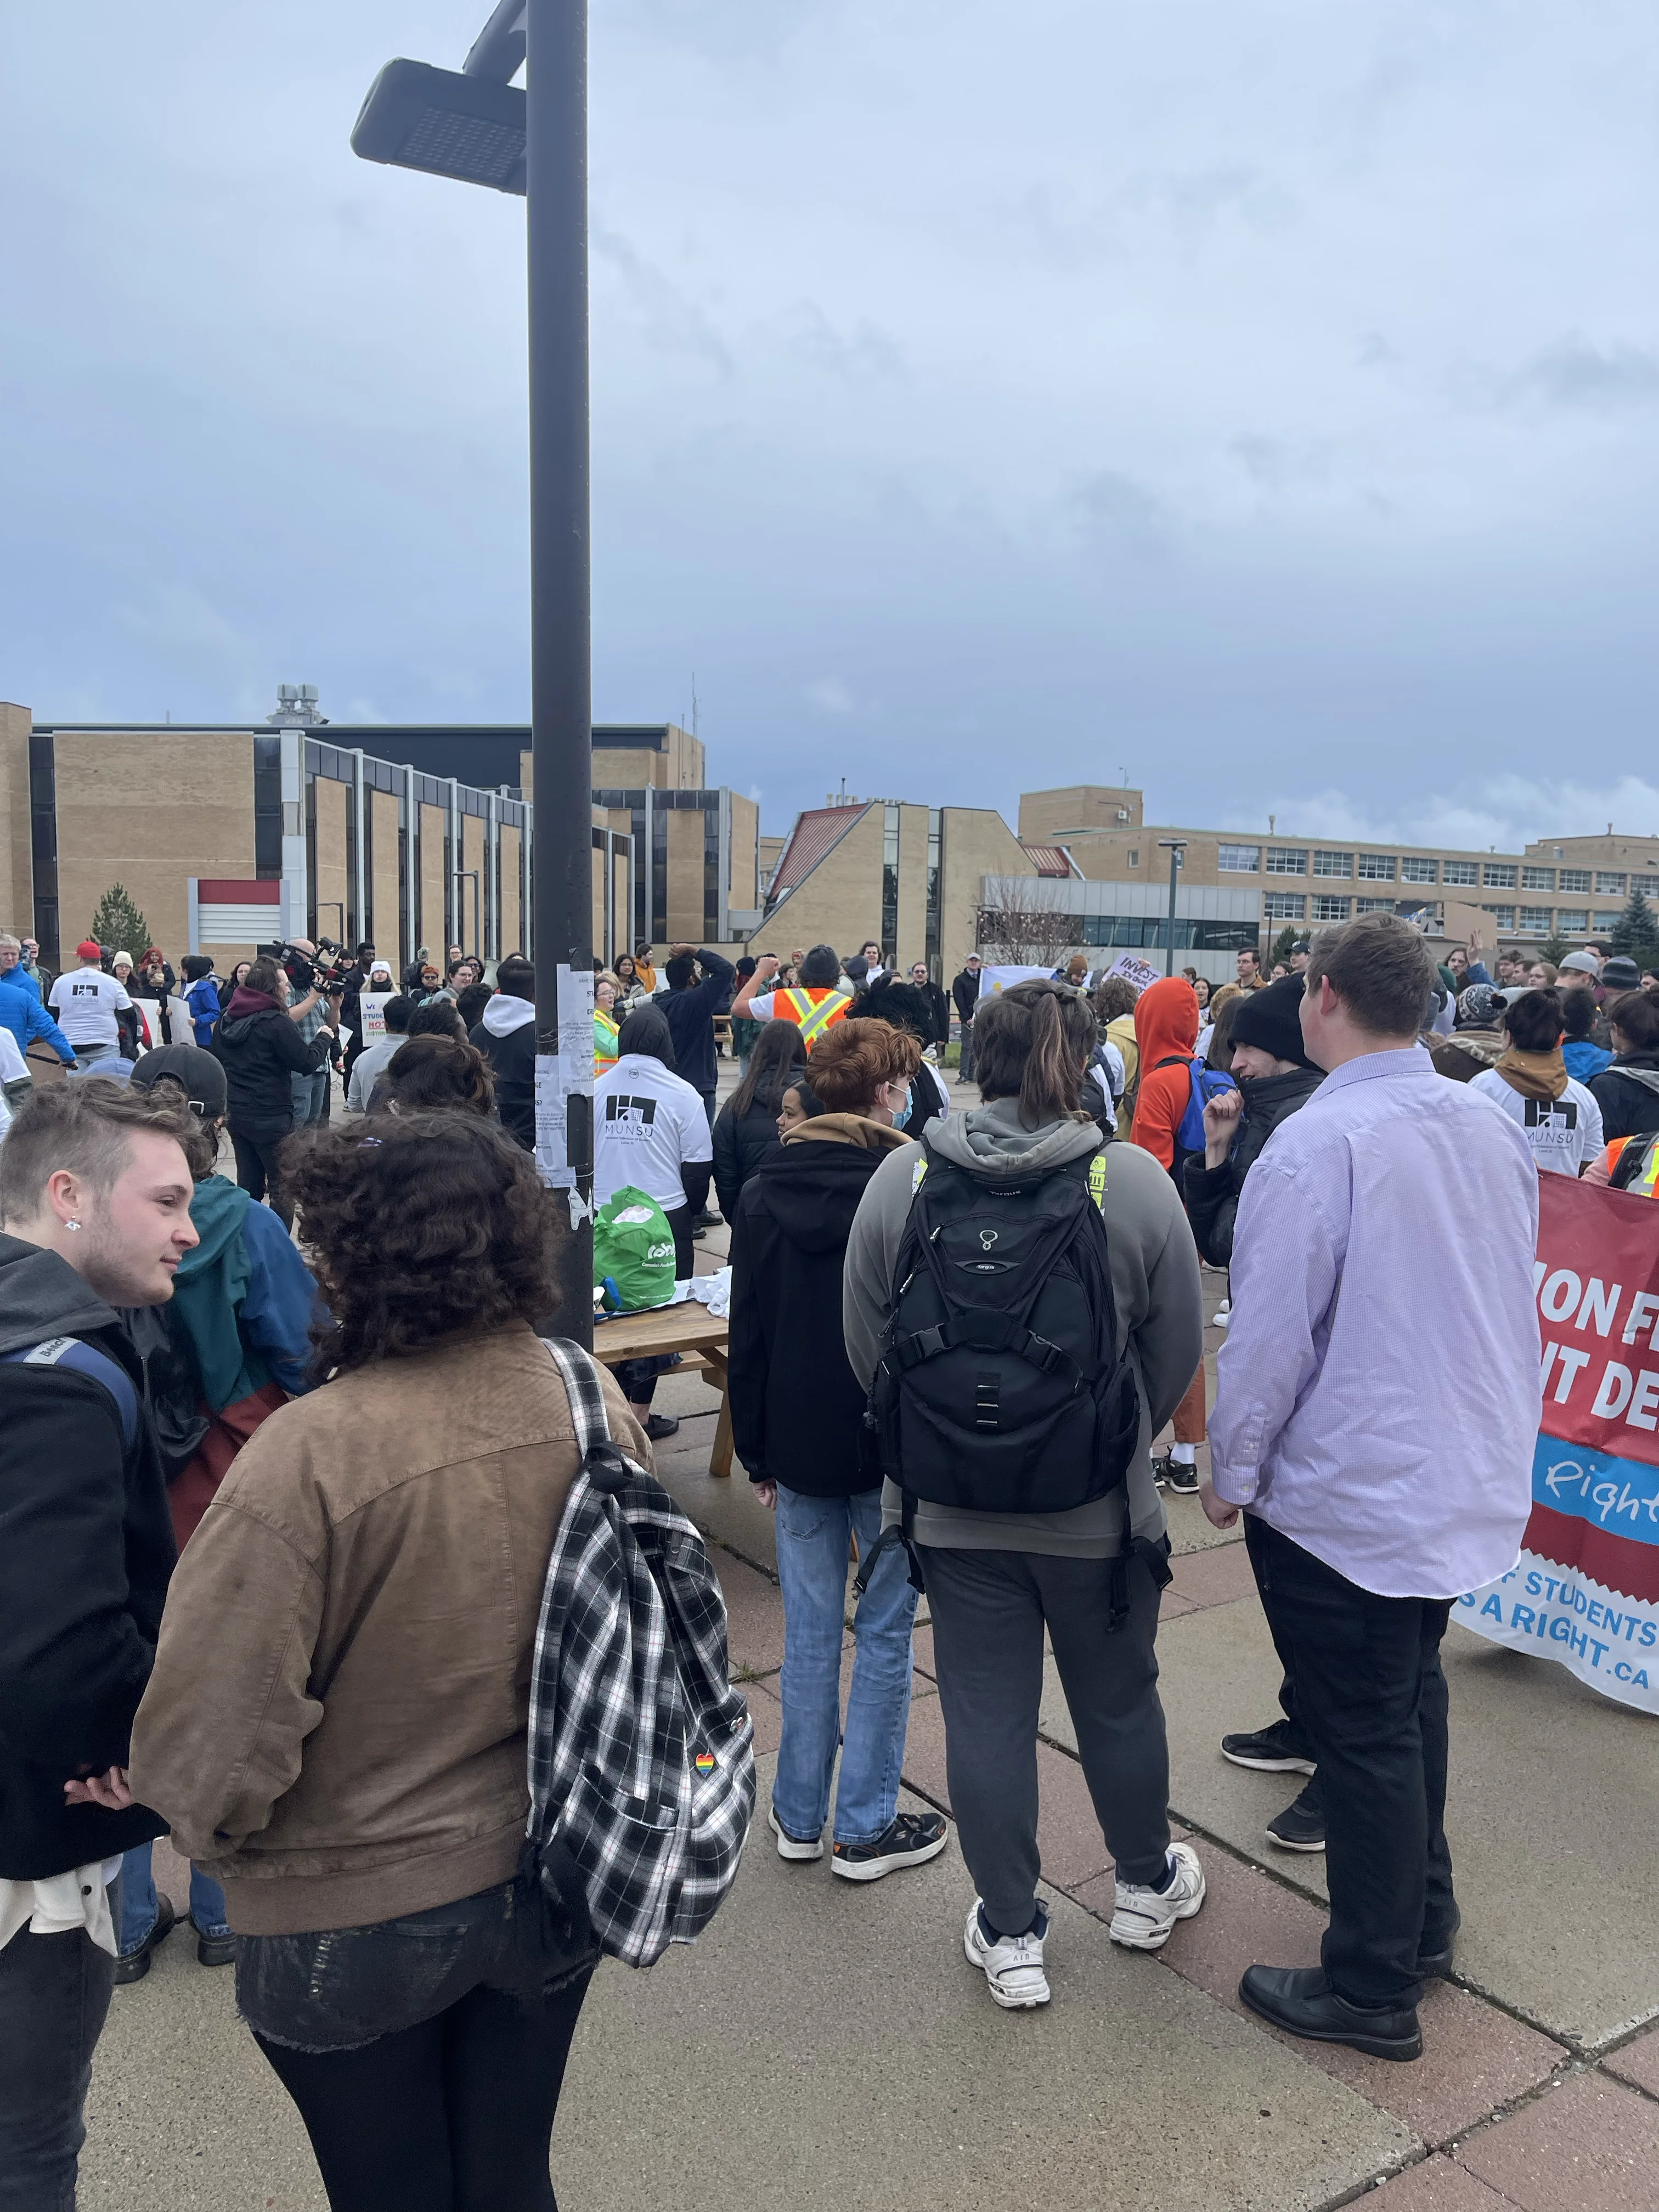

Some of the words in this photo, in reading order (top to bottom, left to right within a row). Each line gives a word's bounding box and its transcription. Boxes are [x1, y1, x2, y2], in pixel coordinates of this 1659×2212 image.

[1120, 957, 1159, 981] INVEST
[605, 1124, 654, 1137] MUNSU
[1590, 1360, 1659, 1431] DE
[1524, 1571, 1658, 1647] STUDENTS
[1123, 1898, 1138, 1908] AIR
[1013, 1953, 1030, 1962] AIR
